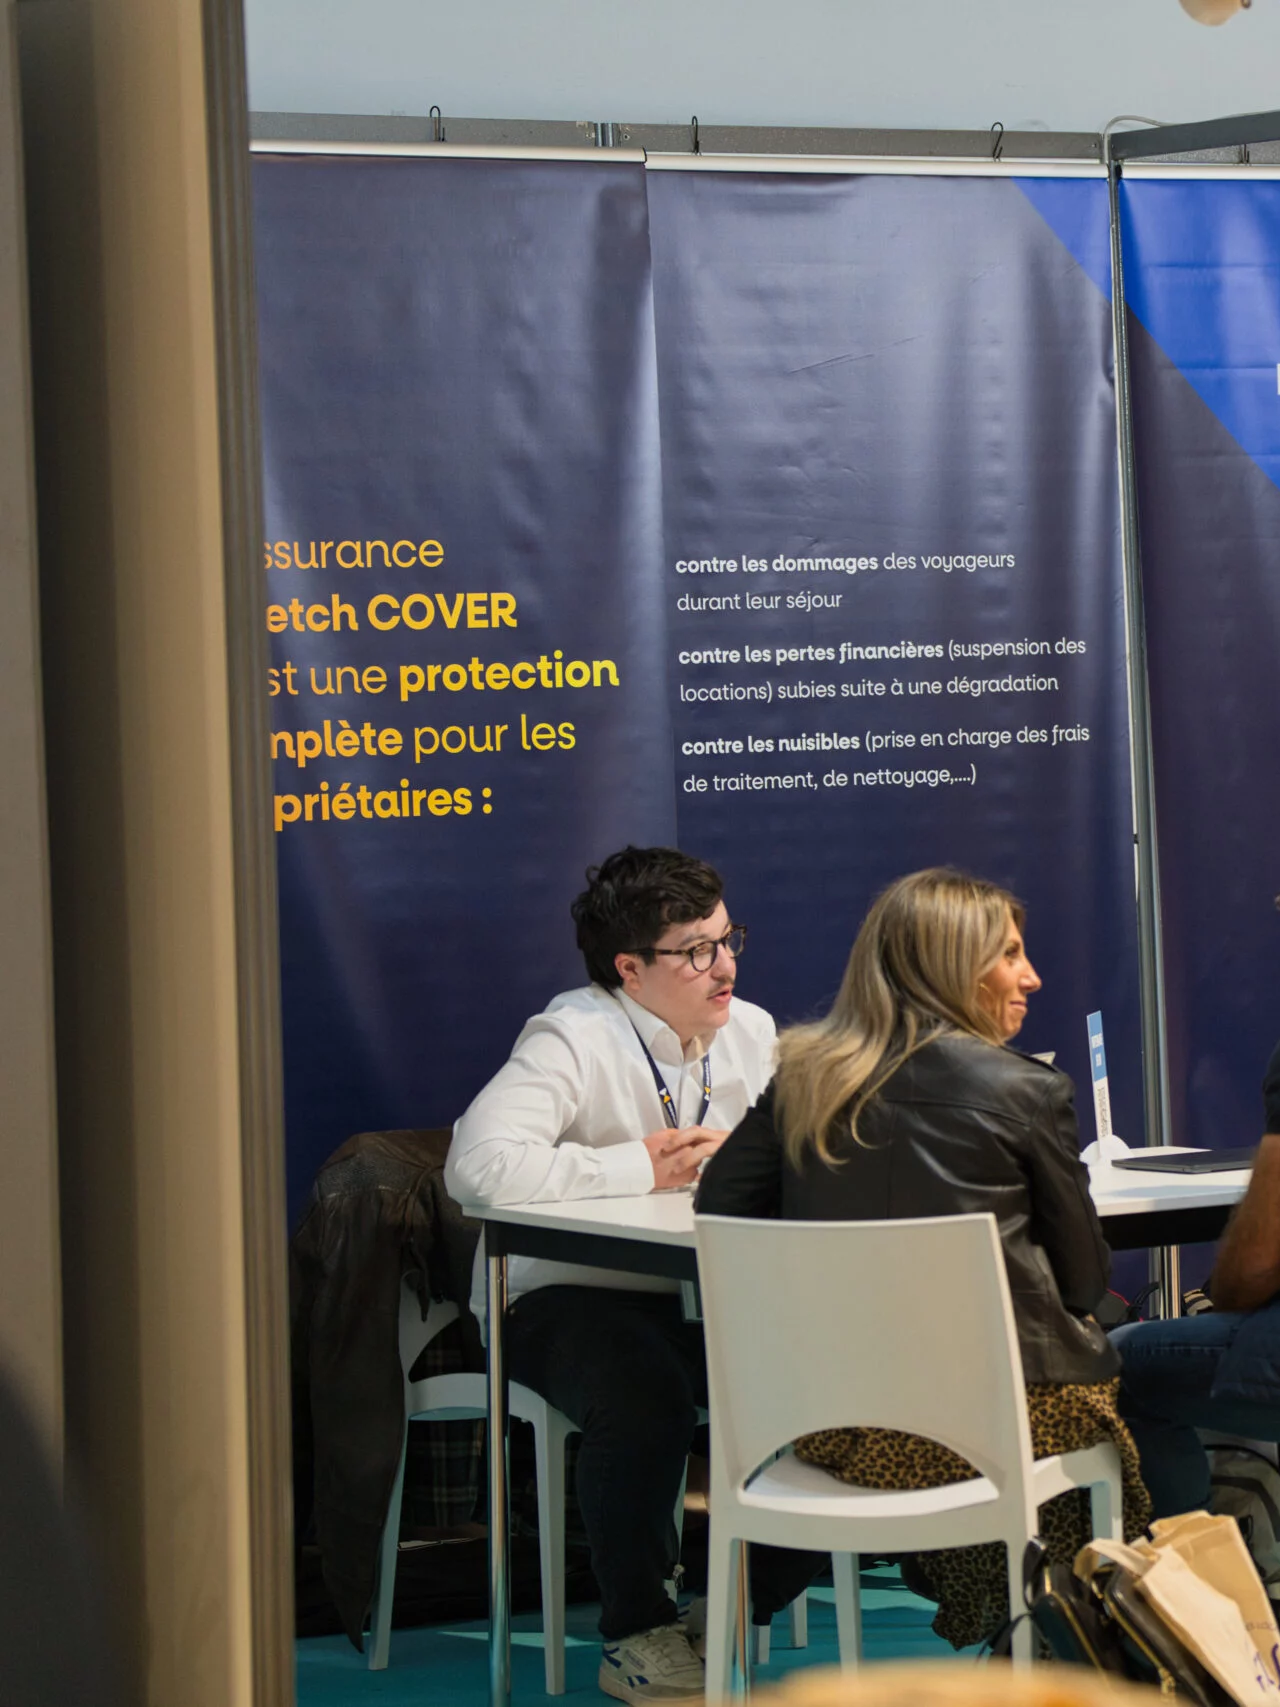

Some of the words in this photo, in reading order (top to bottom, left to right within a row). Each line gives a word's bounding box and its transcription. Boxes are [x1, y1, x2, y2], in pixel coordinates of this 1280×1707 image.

[676, 557, 737, 573] contre
[742, 555, 768, 572] les
[772, 555, 878, 574] dommages
[883, 552, 916, 569] des
[921, 552, 1014, 572] voyageurs
[368, 593, 517, 630] COVER
[677, 594, 741, 610] durant
[746, 592, 781, 609] leur
[787, 591, 842, 612] séjour
[679, 648, 740, 664] contre
[745, 646, 771, 662] les
[776, 646, 835, 665] pertes
[839, 641, 943, 664] financières
[949, 638, 1051, 661] (suspension
[1055, 637, 1086, 654] des
[310, 666, 387, 695] une
[400, 650, 619, 701] protection
[681, 681, 772, 703] locations)
[778, 681, 836, 698] subies
[841, 679, 885, 696] suite
[891, 679, 904, 695] à
[909, 681, 942, 694] une
[947, 674, 1058, 697] dégradation
[415, 725, 508, 763] pour
[521, 714, 575, 750] les
[682, 738, 743, 755] contre
[748, 736, 774, 752] les
[779, 733, 860, 751] nuisibles
[866, 731, 915, 752] (prise
[921, 733, 943, 746] en
[948, 728, 1011, 748] charge
[1017, 726, 1047, 743] des
[1052, 724, 1089, 745] frais
[684, 775, 707, 792] de
[713, 772, 817, 791] traitement,
[823, 770, 848, 787] de
